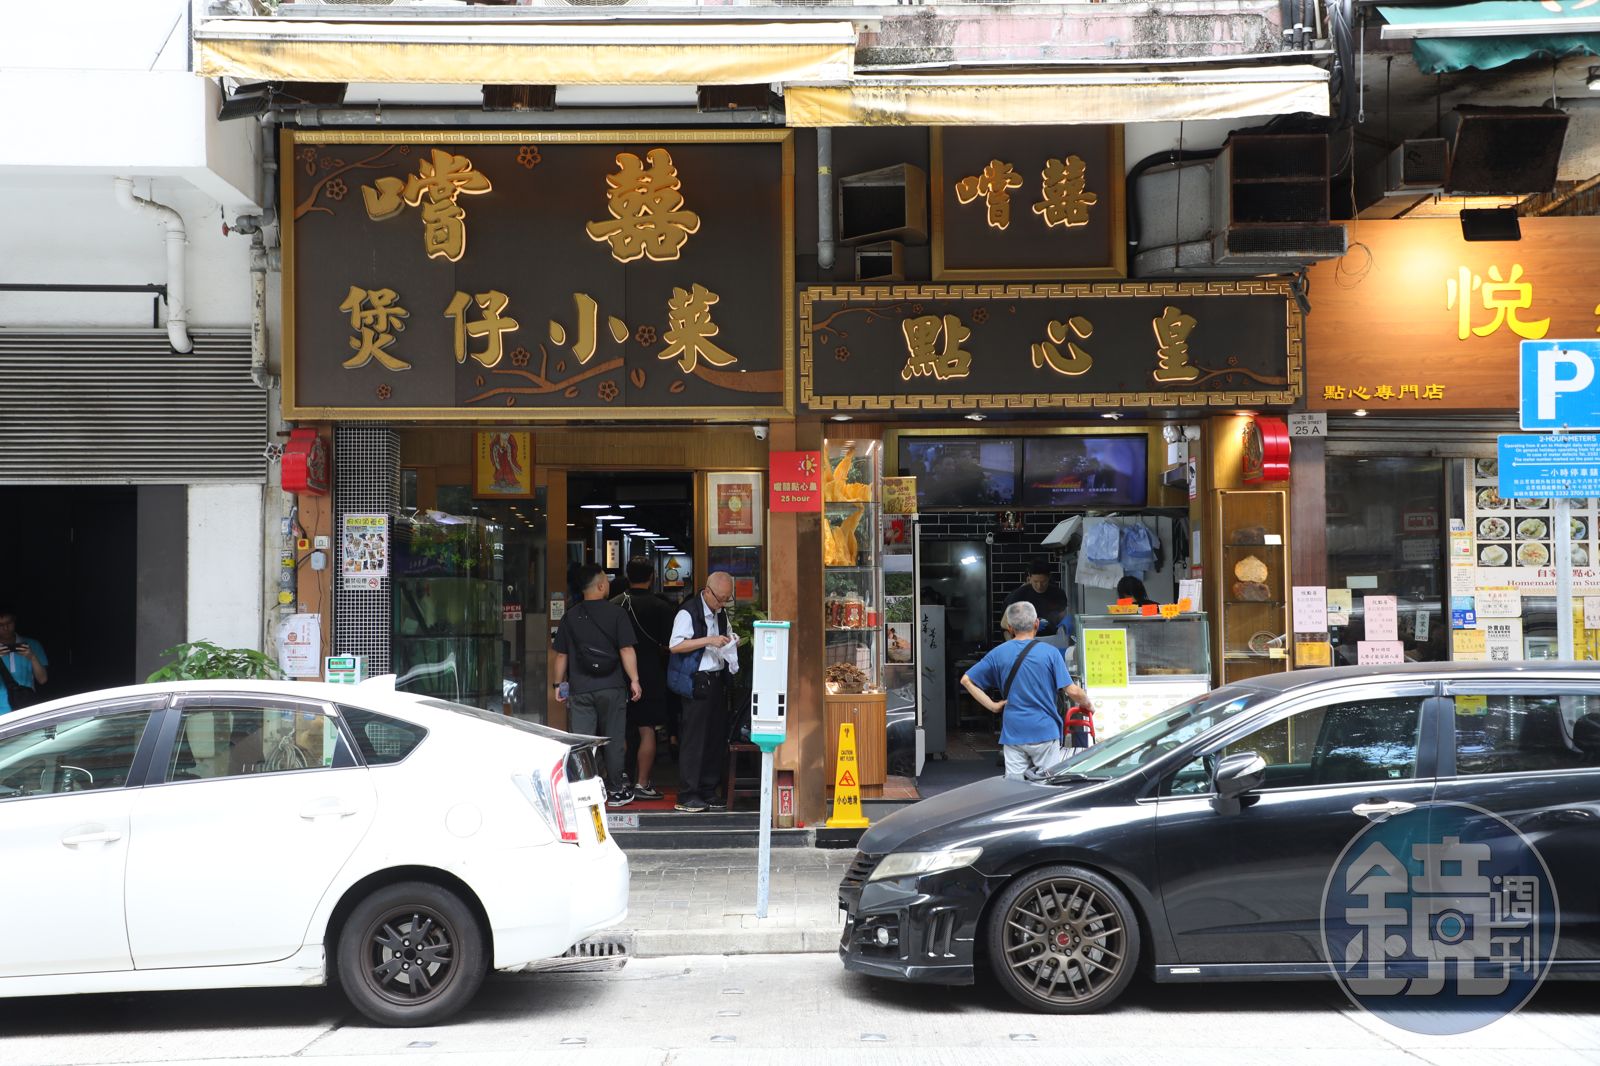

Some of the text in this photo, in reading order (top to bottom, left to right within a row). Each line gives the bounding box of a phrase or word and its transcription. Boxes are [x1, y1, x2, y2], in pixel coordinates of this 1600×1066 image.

[339, 282, 739, 374] 煲仔小菜
[901, 304, 1200, 382] 點心皇
[1323, 383, 1446, 401] 點心專門店
[1537, 349, 1595, 420] P
[1295, 426, 1320, 435] 25 A
